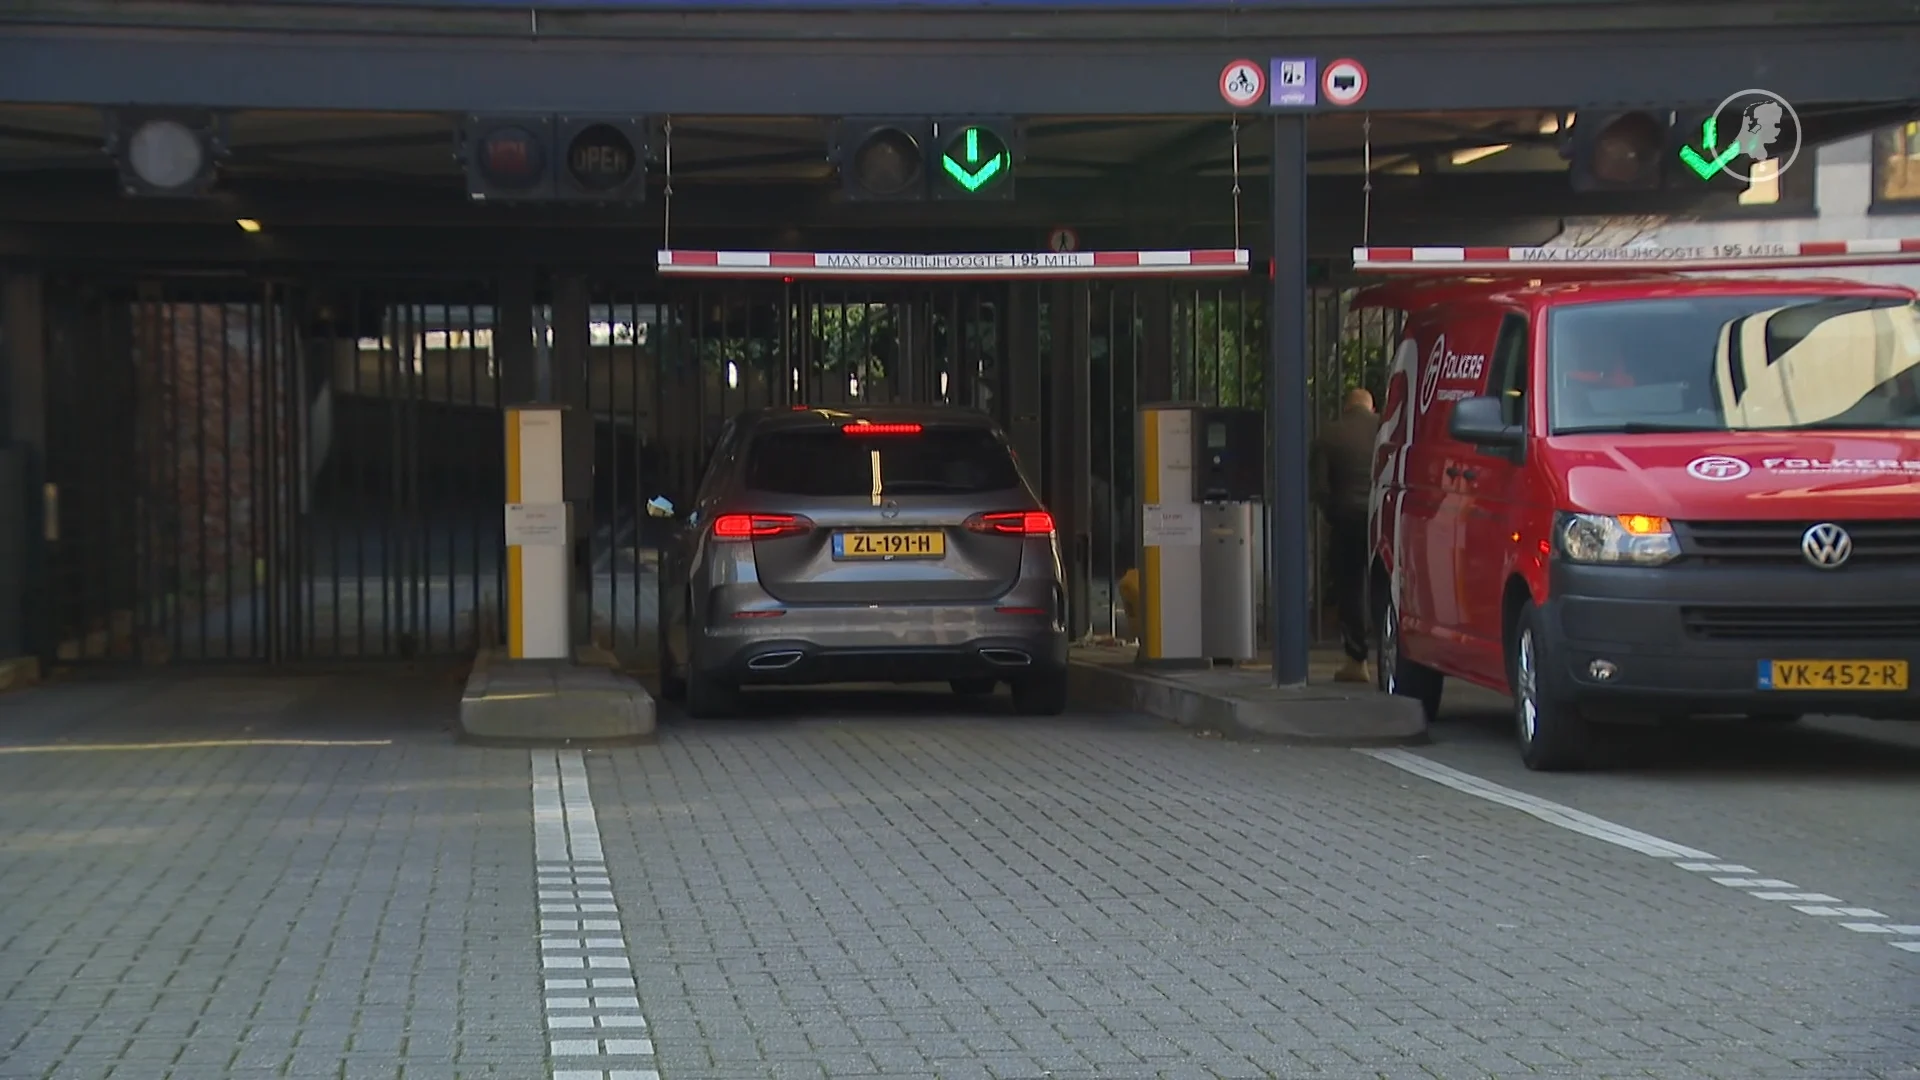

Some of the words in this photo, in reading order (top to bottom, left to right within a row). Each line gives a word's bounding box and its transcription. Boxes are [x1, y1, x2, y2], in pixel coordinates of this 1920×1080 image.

[1441, 350, 1485, 379] FOLKERS
[853, 535, 930, 553] ZL-191-H
[1780, 664, 1898, 686] VK-452-R
